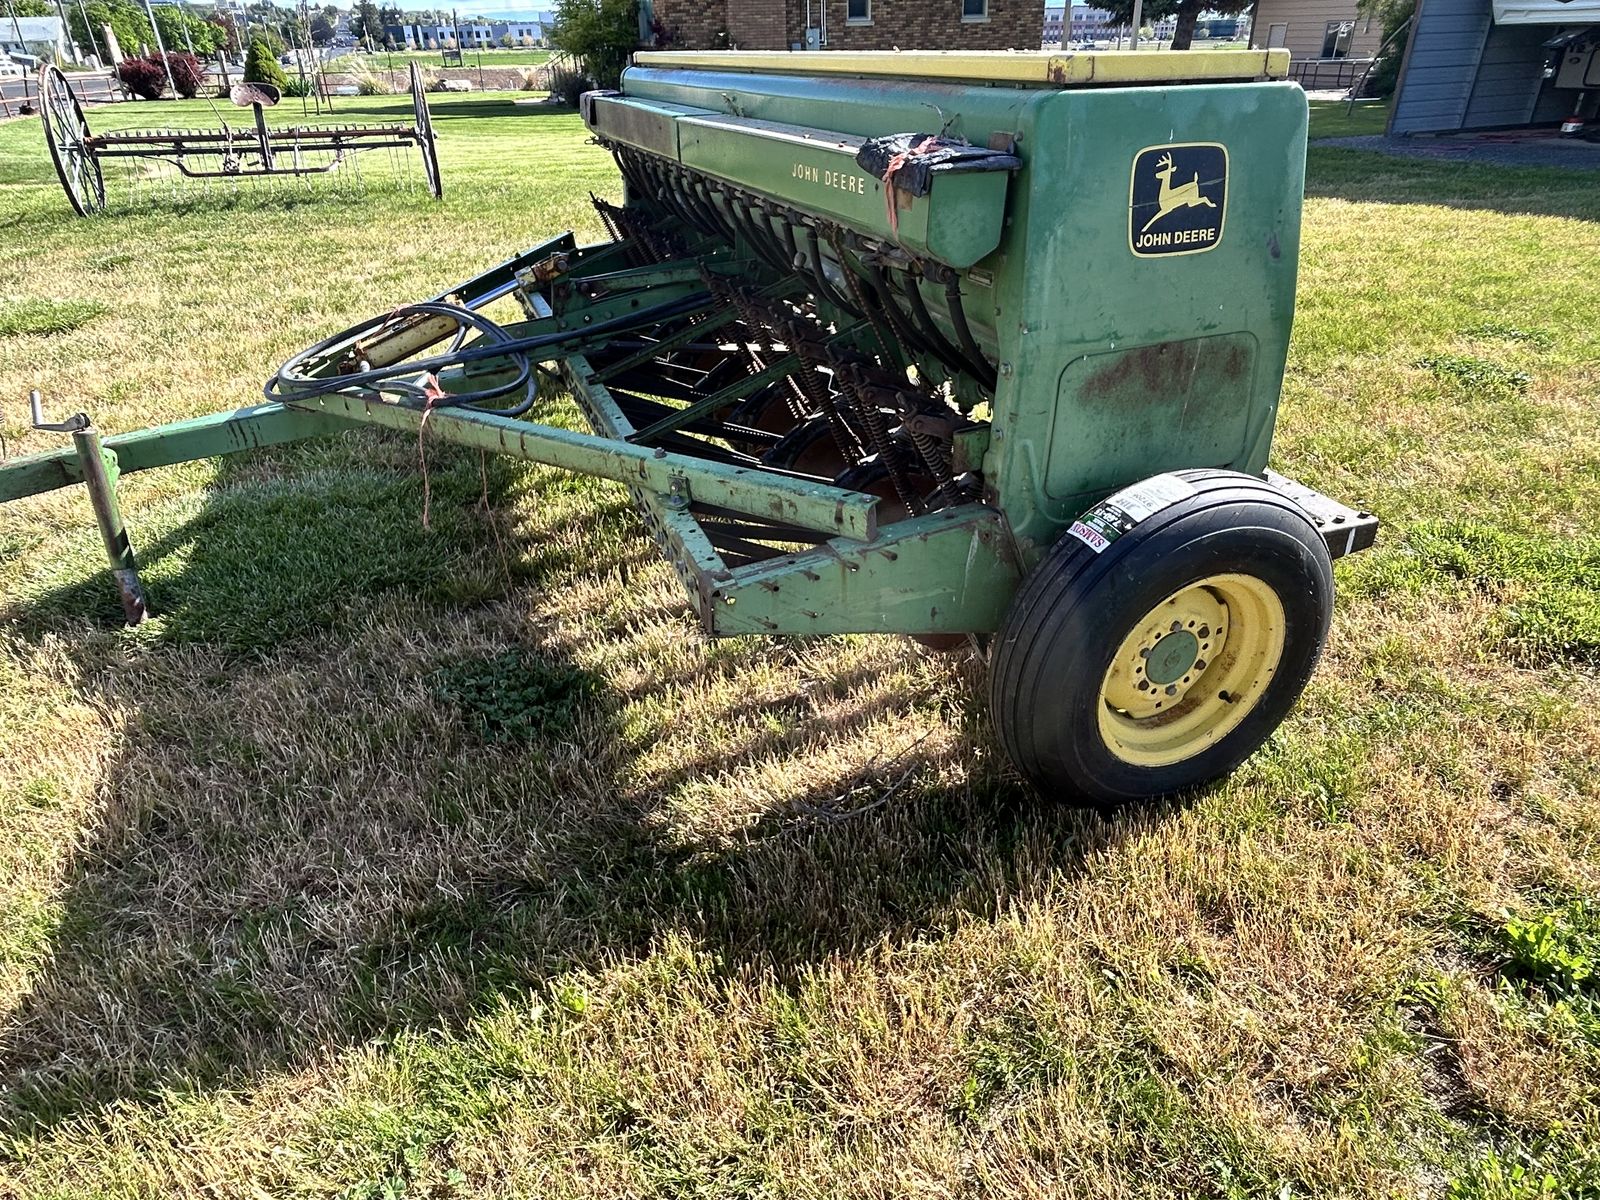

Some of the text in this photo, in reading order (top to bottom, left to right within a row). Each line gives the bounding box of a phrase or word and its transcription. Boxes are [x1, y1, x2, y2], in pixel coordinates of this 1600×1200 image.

[792, 164, 865, 195] JOHN DEERE
[1136, 228, 1216, 248] JOHN DEERE
